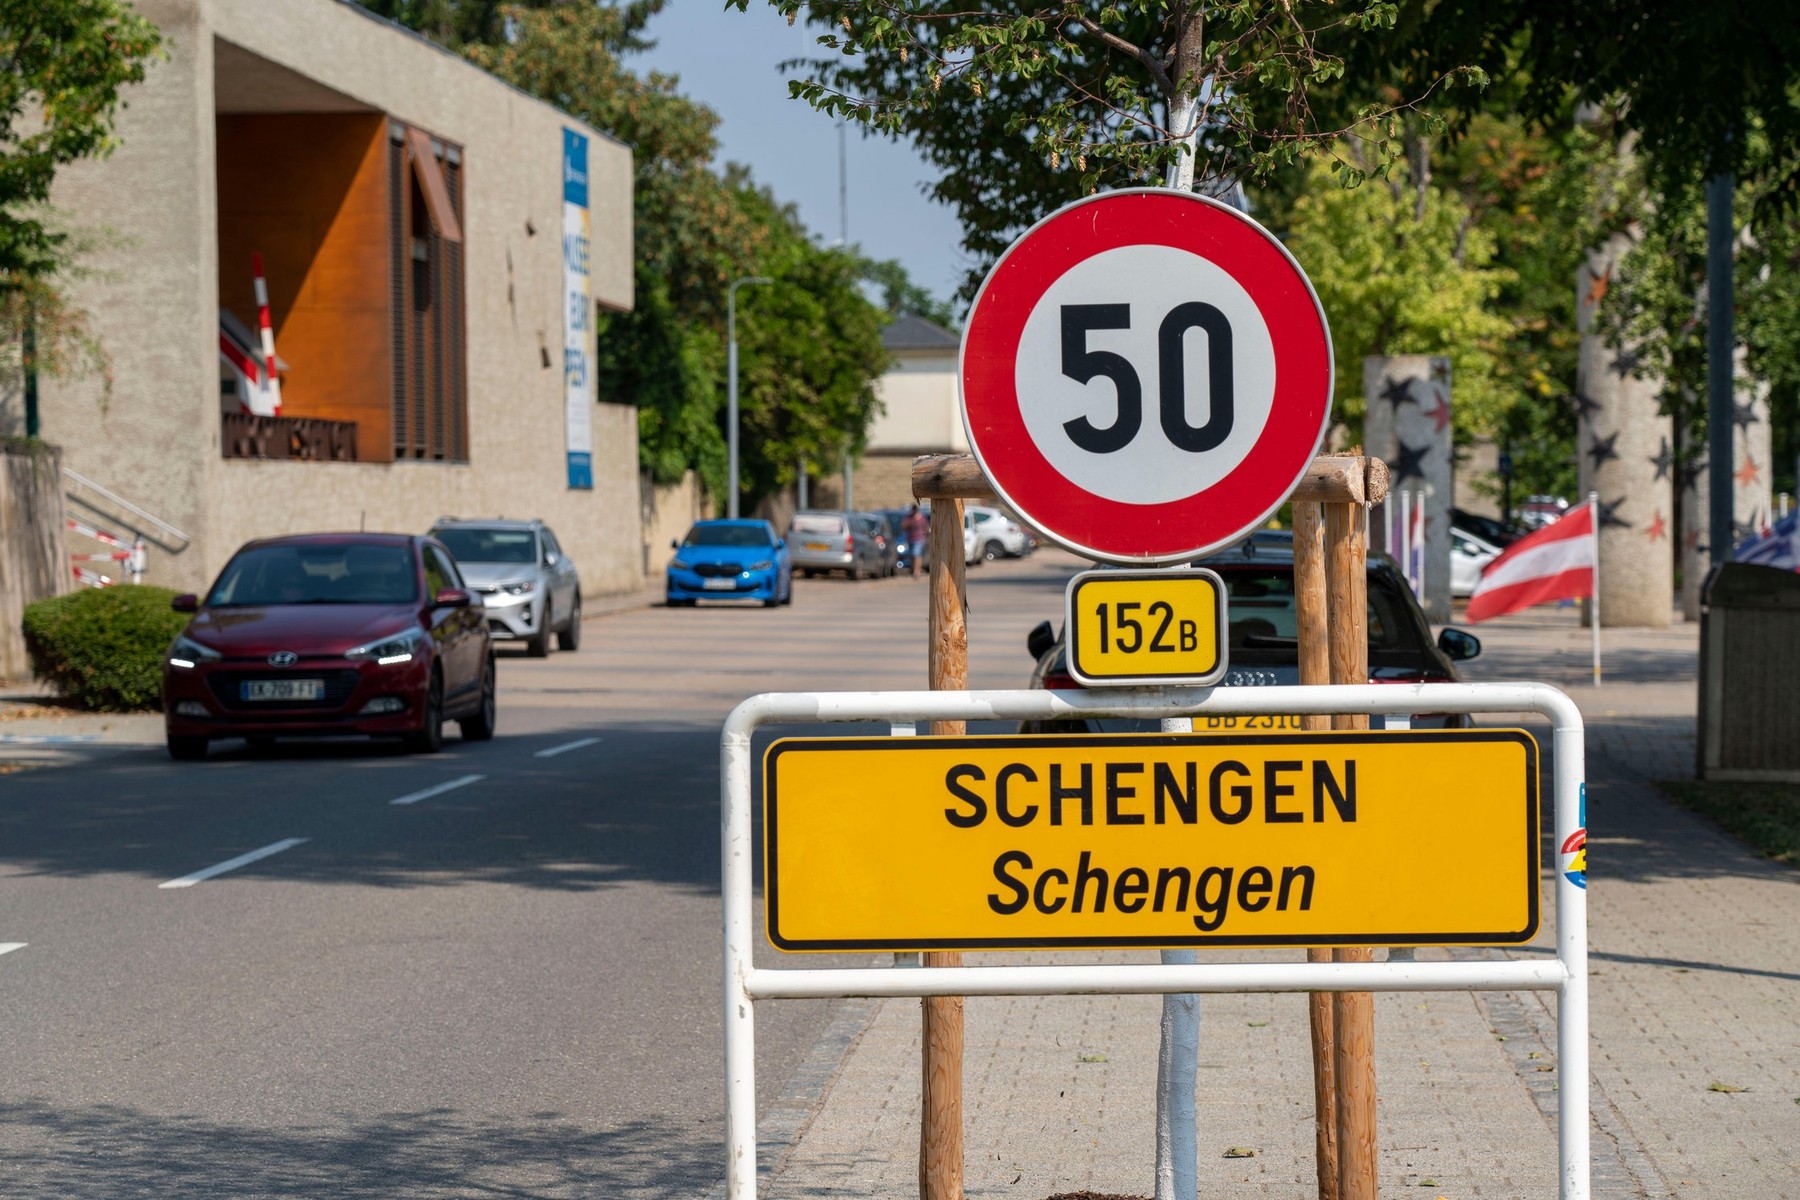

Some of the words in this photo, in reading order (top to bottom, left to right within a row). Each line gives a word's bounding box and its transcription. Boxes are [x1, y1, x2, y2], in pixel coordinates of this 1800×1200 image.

[1060, 301, 1235, 454] 50
[1095, 600, 1198, 654] 152B
[944, 760, 1357, 829] SCHENGEN
[987, 850, 1316, 932] Schengen
